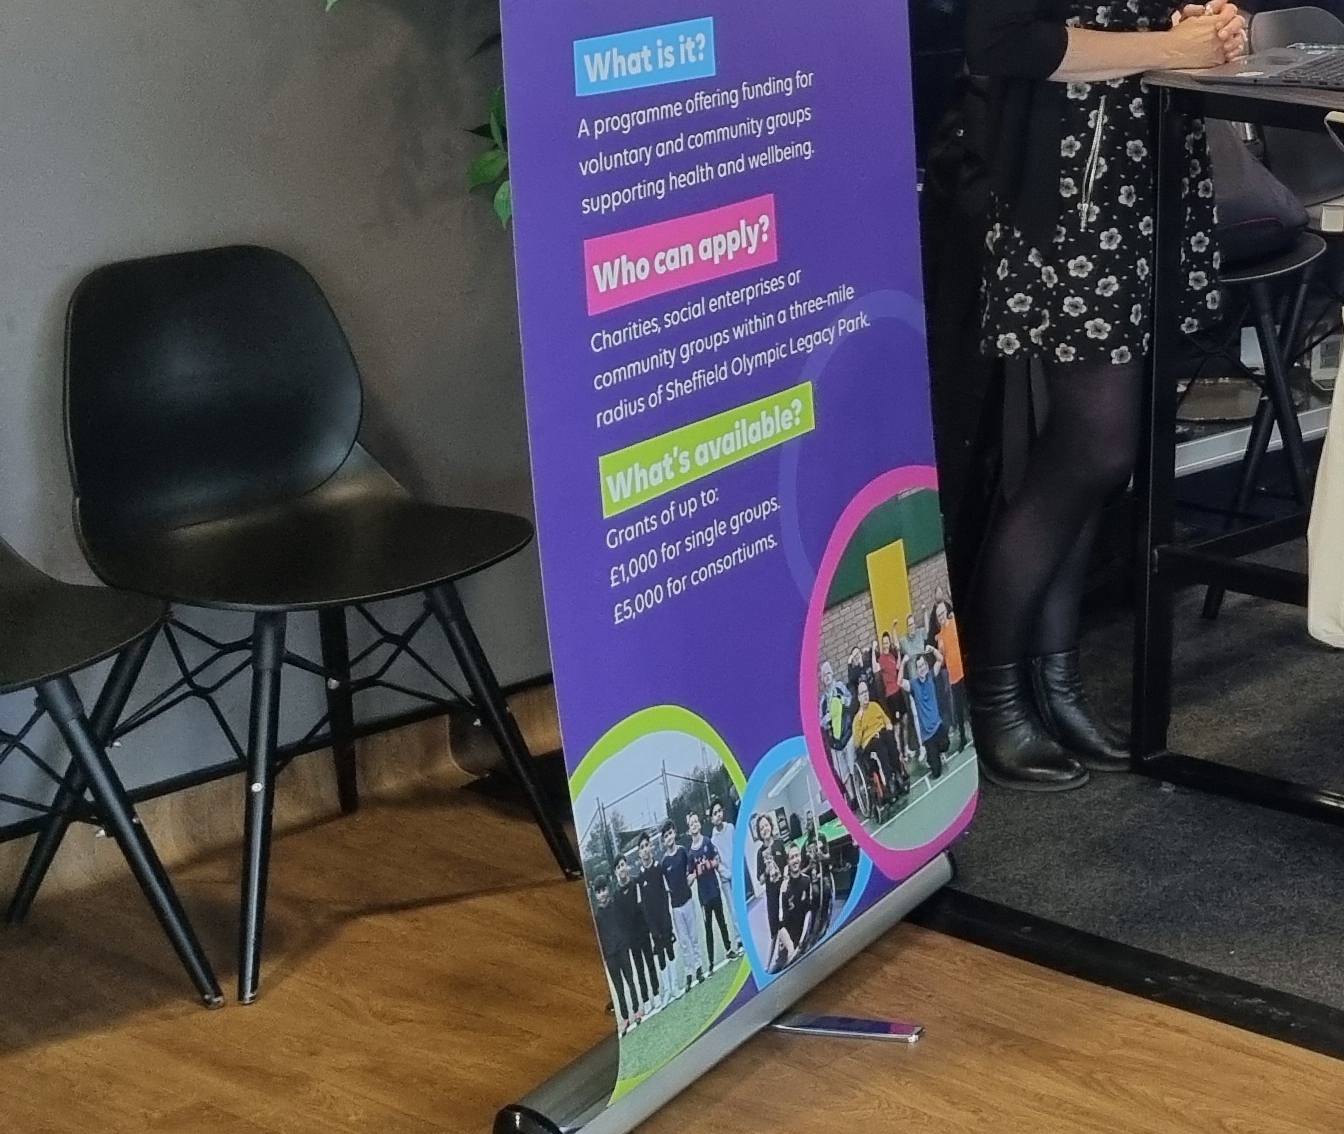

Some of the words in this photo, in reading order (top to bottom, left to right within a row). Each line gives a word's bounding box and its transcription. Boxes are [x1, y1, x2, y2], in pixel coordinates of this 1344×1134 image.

[583, 45, 653, 83] What
[656, 39, 676, 68] is
[679, 32, 707, 64] it?
[577, 118, 590, 139] A
[594, 100, 683, 140] programme
[685, 88, 739, 114] offering
[741, 74, 793, 99] funding
[795, 70, 815, 89] for
[578, 145, 653, 177] voluntary
[655, 136, 684, 159] and
[687, 118, 762, 150] community
[766, 105, 812, 133] groups
[581, 178, 665, 215] supporting
[668, 164, 715, 191] health
[717, 156, 746, 179] and
[748, 141, 816, 171] wellbeing.
[592, 254, 650, 293] Who
[653, 242, 695, 274] can
[699, 215, 771, 264] apply?
[590, 318, 662, 354] Charities,
[664, 298, 706, 329] social
[709, 273, 786, 314] enterprises
[787, 269, 802, 288] or
[593, 350, 676, 391] community
[679, 331, 730, 367] groups
[732, 314, 775, 342] within
[777, 310, 788, 325] a
[789, 284, 855, 321] three-mile
[595, 398, 645, 429] radius
[648, 383, 665, 409] of
[665, 365, 728, 401] Sheffield
[731, 344, 788, 377] Olympic
[789, 325, 835, 356] Legacy
[838, 311, 871, 337] Park.
[605, 447, 692, 504] What's
[694, 398, 802, 467] available?
[605, 514, 658, 550] Grants
[661, 500, 677, 525] of
[679, 496, 698, 520] up
[700, 486, 720, 506] to:
[610, 549, 659, 589] £1,000
[661, 538, 683, 561] for
[684, 518, 727, 553] single
[730, 496, 781, 534] groups.
[613, 586, 664, 626] £5,000
[667, 573, 688, 596] for
[690, 533, 778, 587] consortiums.
